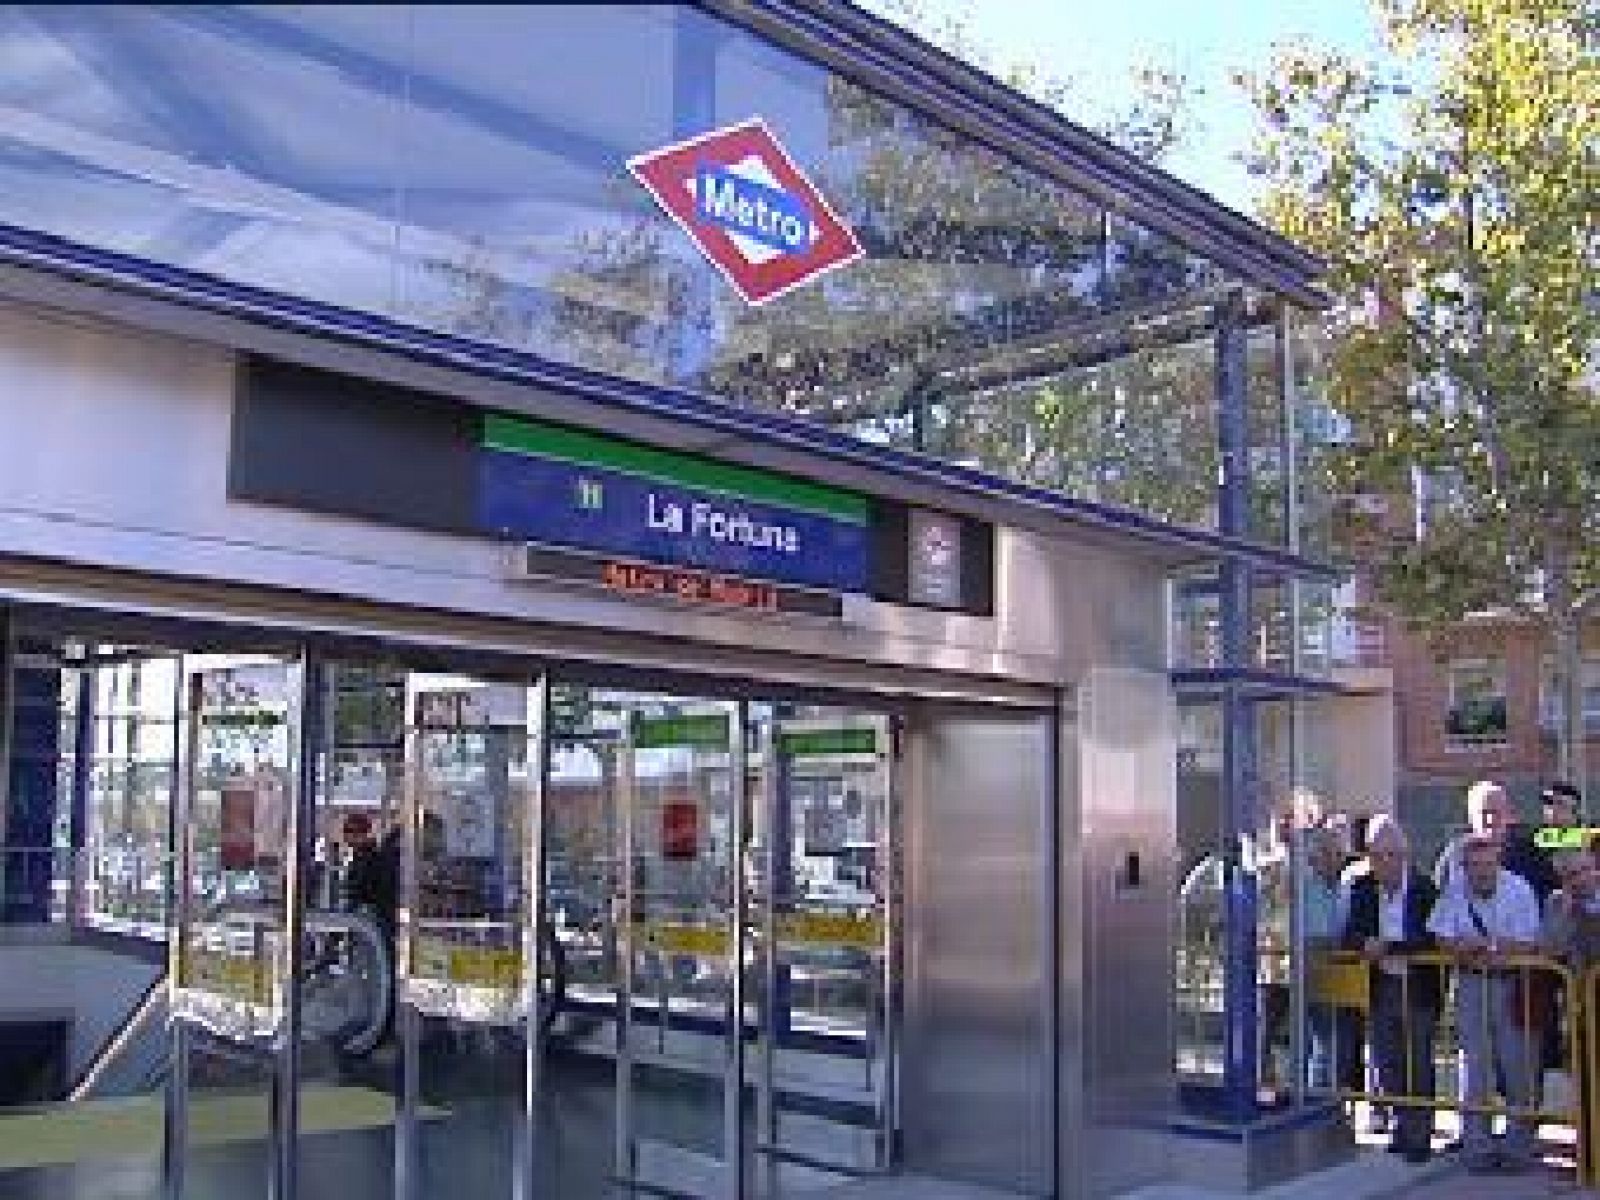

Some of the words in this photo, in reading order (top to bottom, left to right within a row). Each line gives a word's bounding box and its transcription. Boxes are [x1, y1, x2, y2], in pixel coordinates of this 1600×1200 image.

[704, 173, 803, 246] Metro
[648, 493, 684, 533] La
[691, 502, 799, 552] Fortuna
